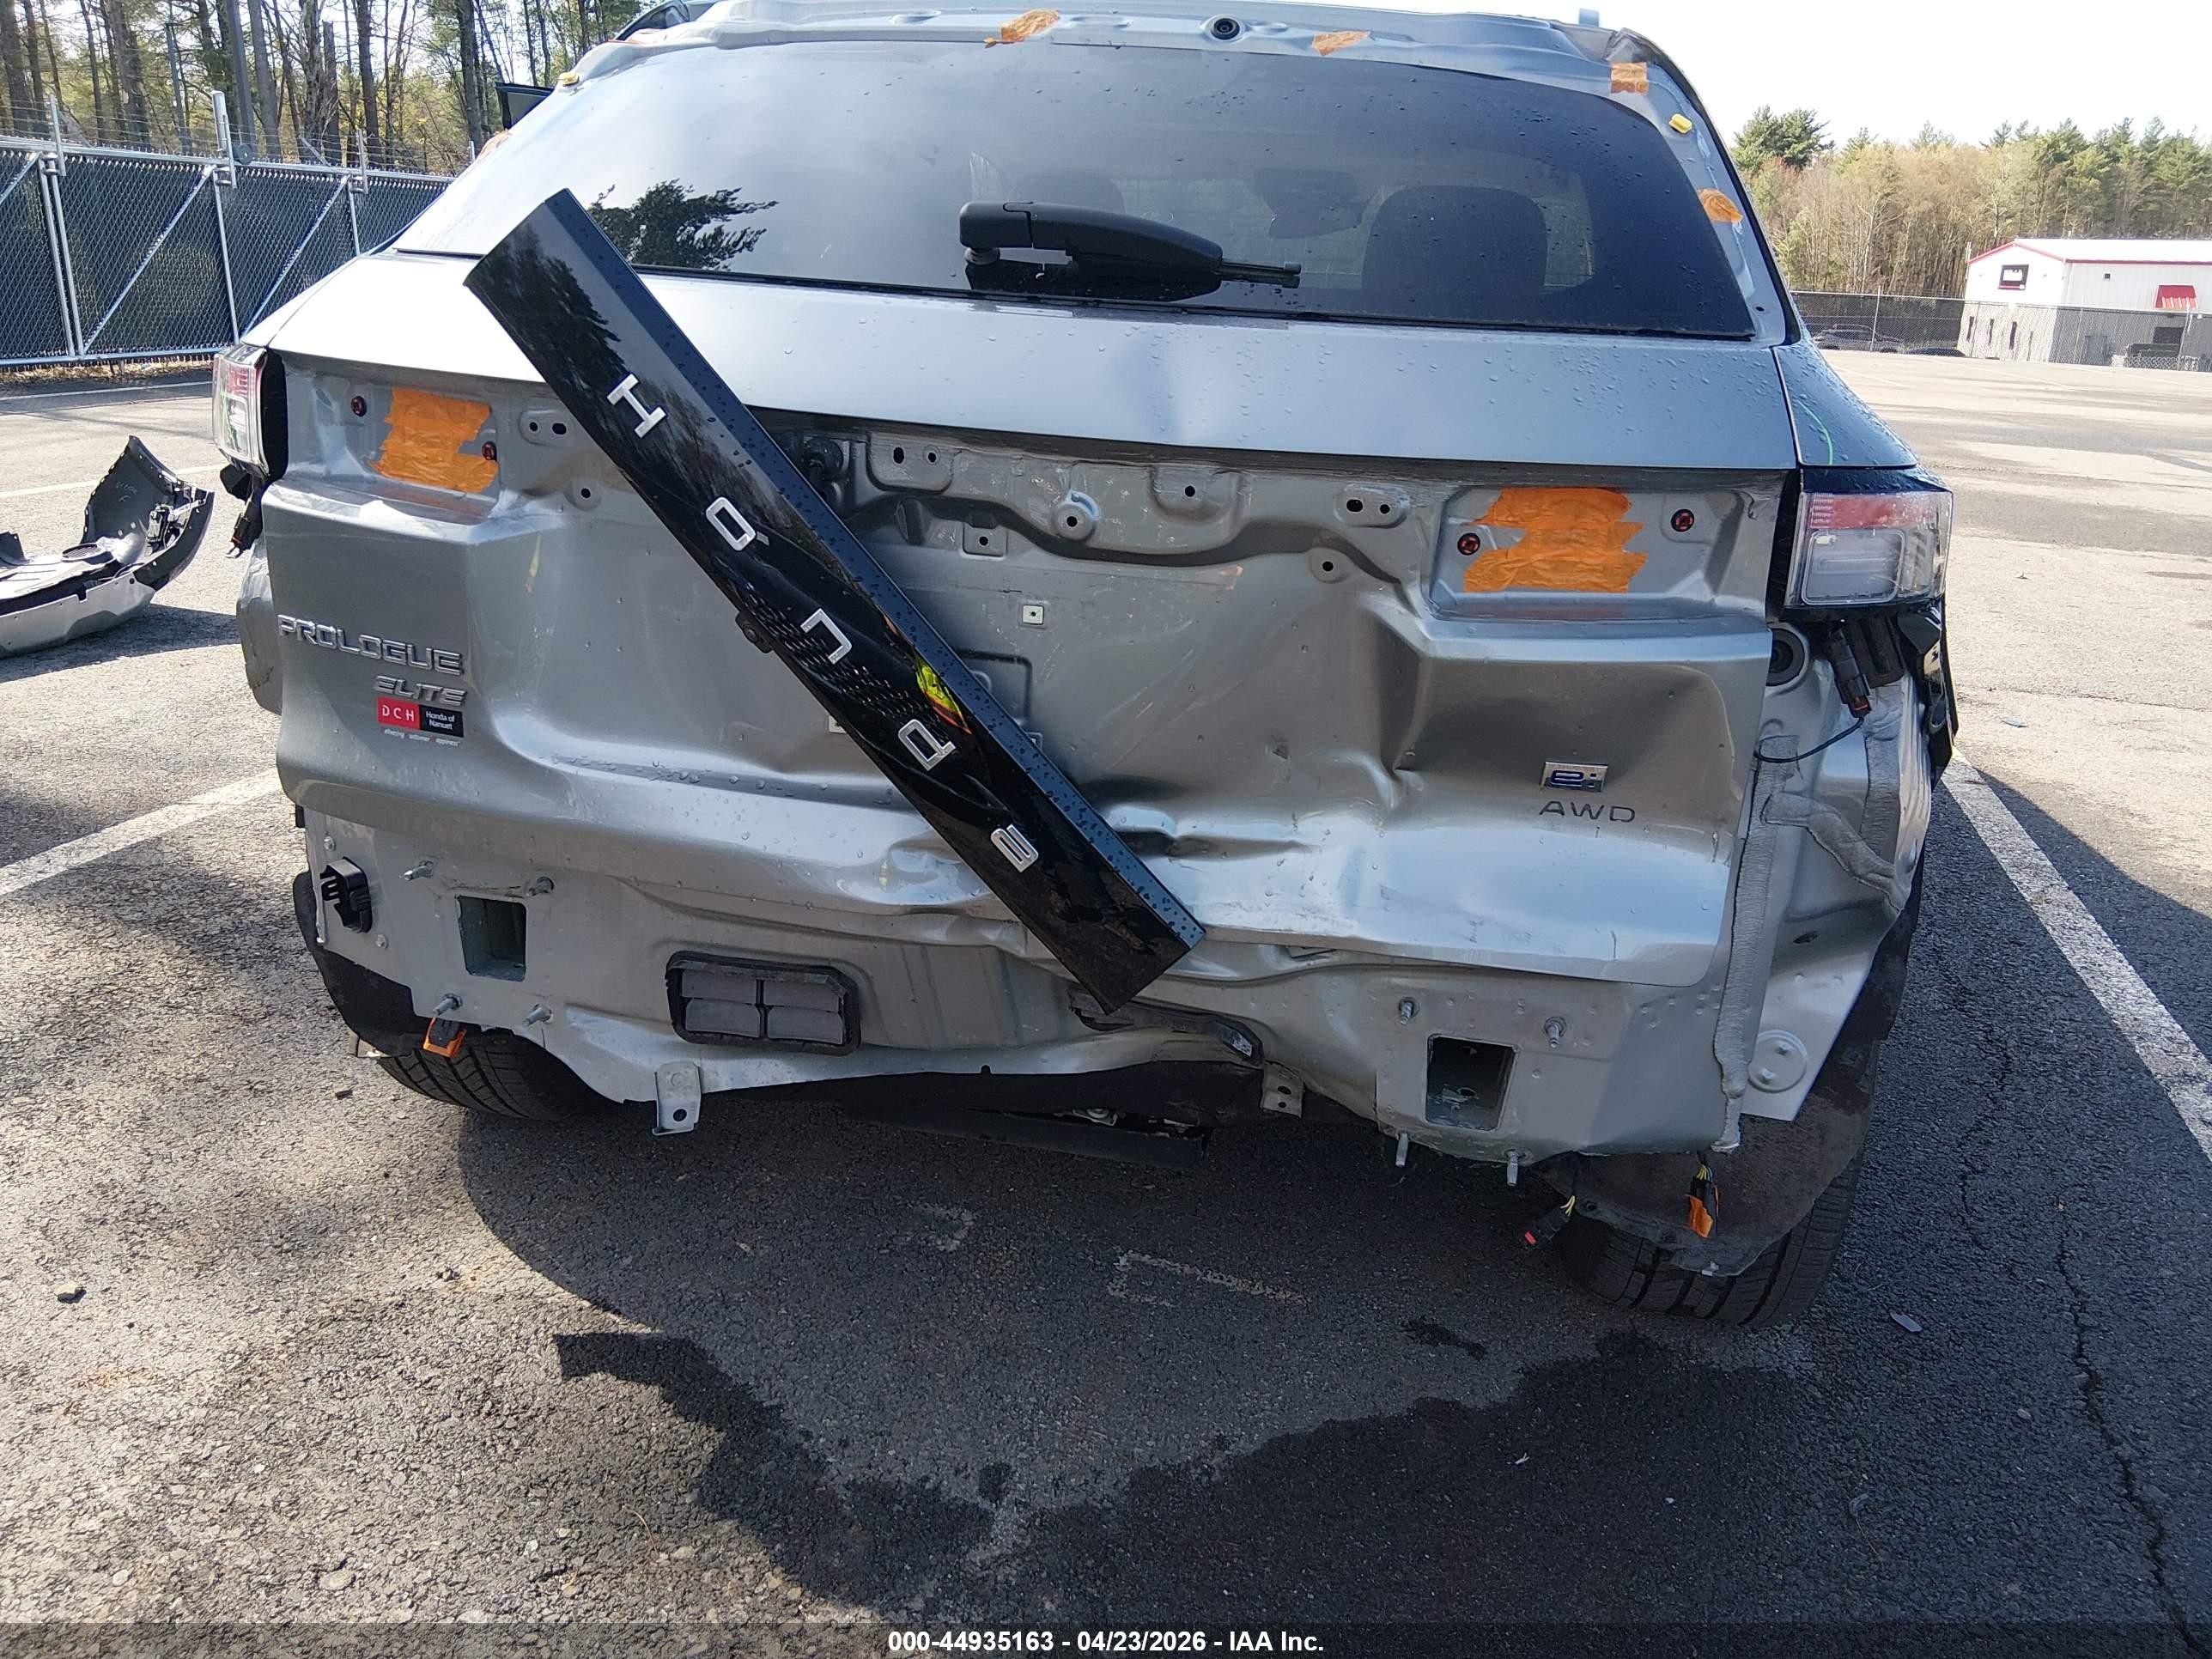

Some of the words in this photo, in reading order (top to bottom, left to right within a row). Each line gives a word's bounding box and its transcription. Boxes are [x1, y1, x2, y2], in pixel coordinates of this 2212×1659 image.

[277, 614, 465, 676] PROLOGUE
[374, 675, 467, 706] ELITE
[381, 704, 415, 722] DCH
[425, 710, 447, 721] Honda
[1538, 799, 1637, 823] AWD
